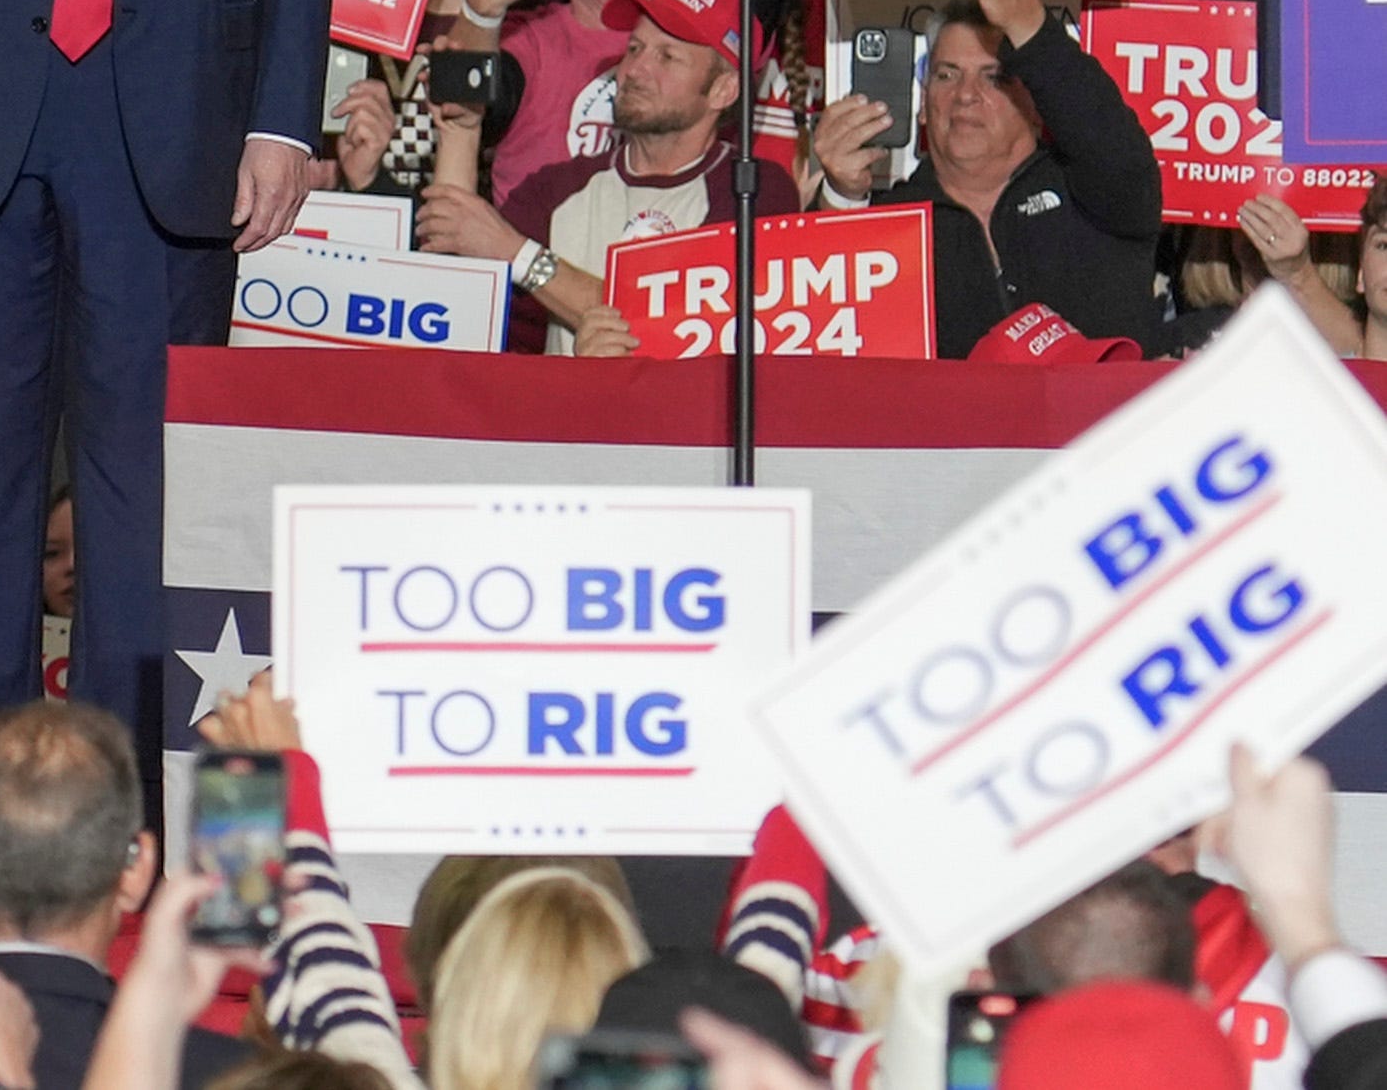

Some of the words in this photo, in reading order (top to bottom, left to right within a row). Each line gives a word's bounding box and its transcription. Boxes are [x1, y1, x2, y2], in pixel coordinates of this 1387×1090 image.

[1116, 41, 1257, 100] TRU
[1150, 99, 1283, 156] 202
[1173, 162, 1256, 184] TRUMP
[1264, 166, 1294, 186] TO
[1302, 168, 1376, 188] 88022
[241, 277, 328, 328] OO
[345, 293, 451, 345] BIG
[636, 251, 899, 318] TRUMP
[340, 565, 534, 632] TOO
[565, 565, 727, 633] BIG
[843, 583, 1074, 762] TOO
[1082, 429, 1277, 592] BIG
[376, 689, 496, 757] TO
[527, 689, 689, 757] RIG
[954, 718, 1112, 828] TO
[1117, 560, 1308, 732] RIG
